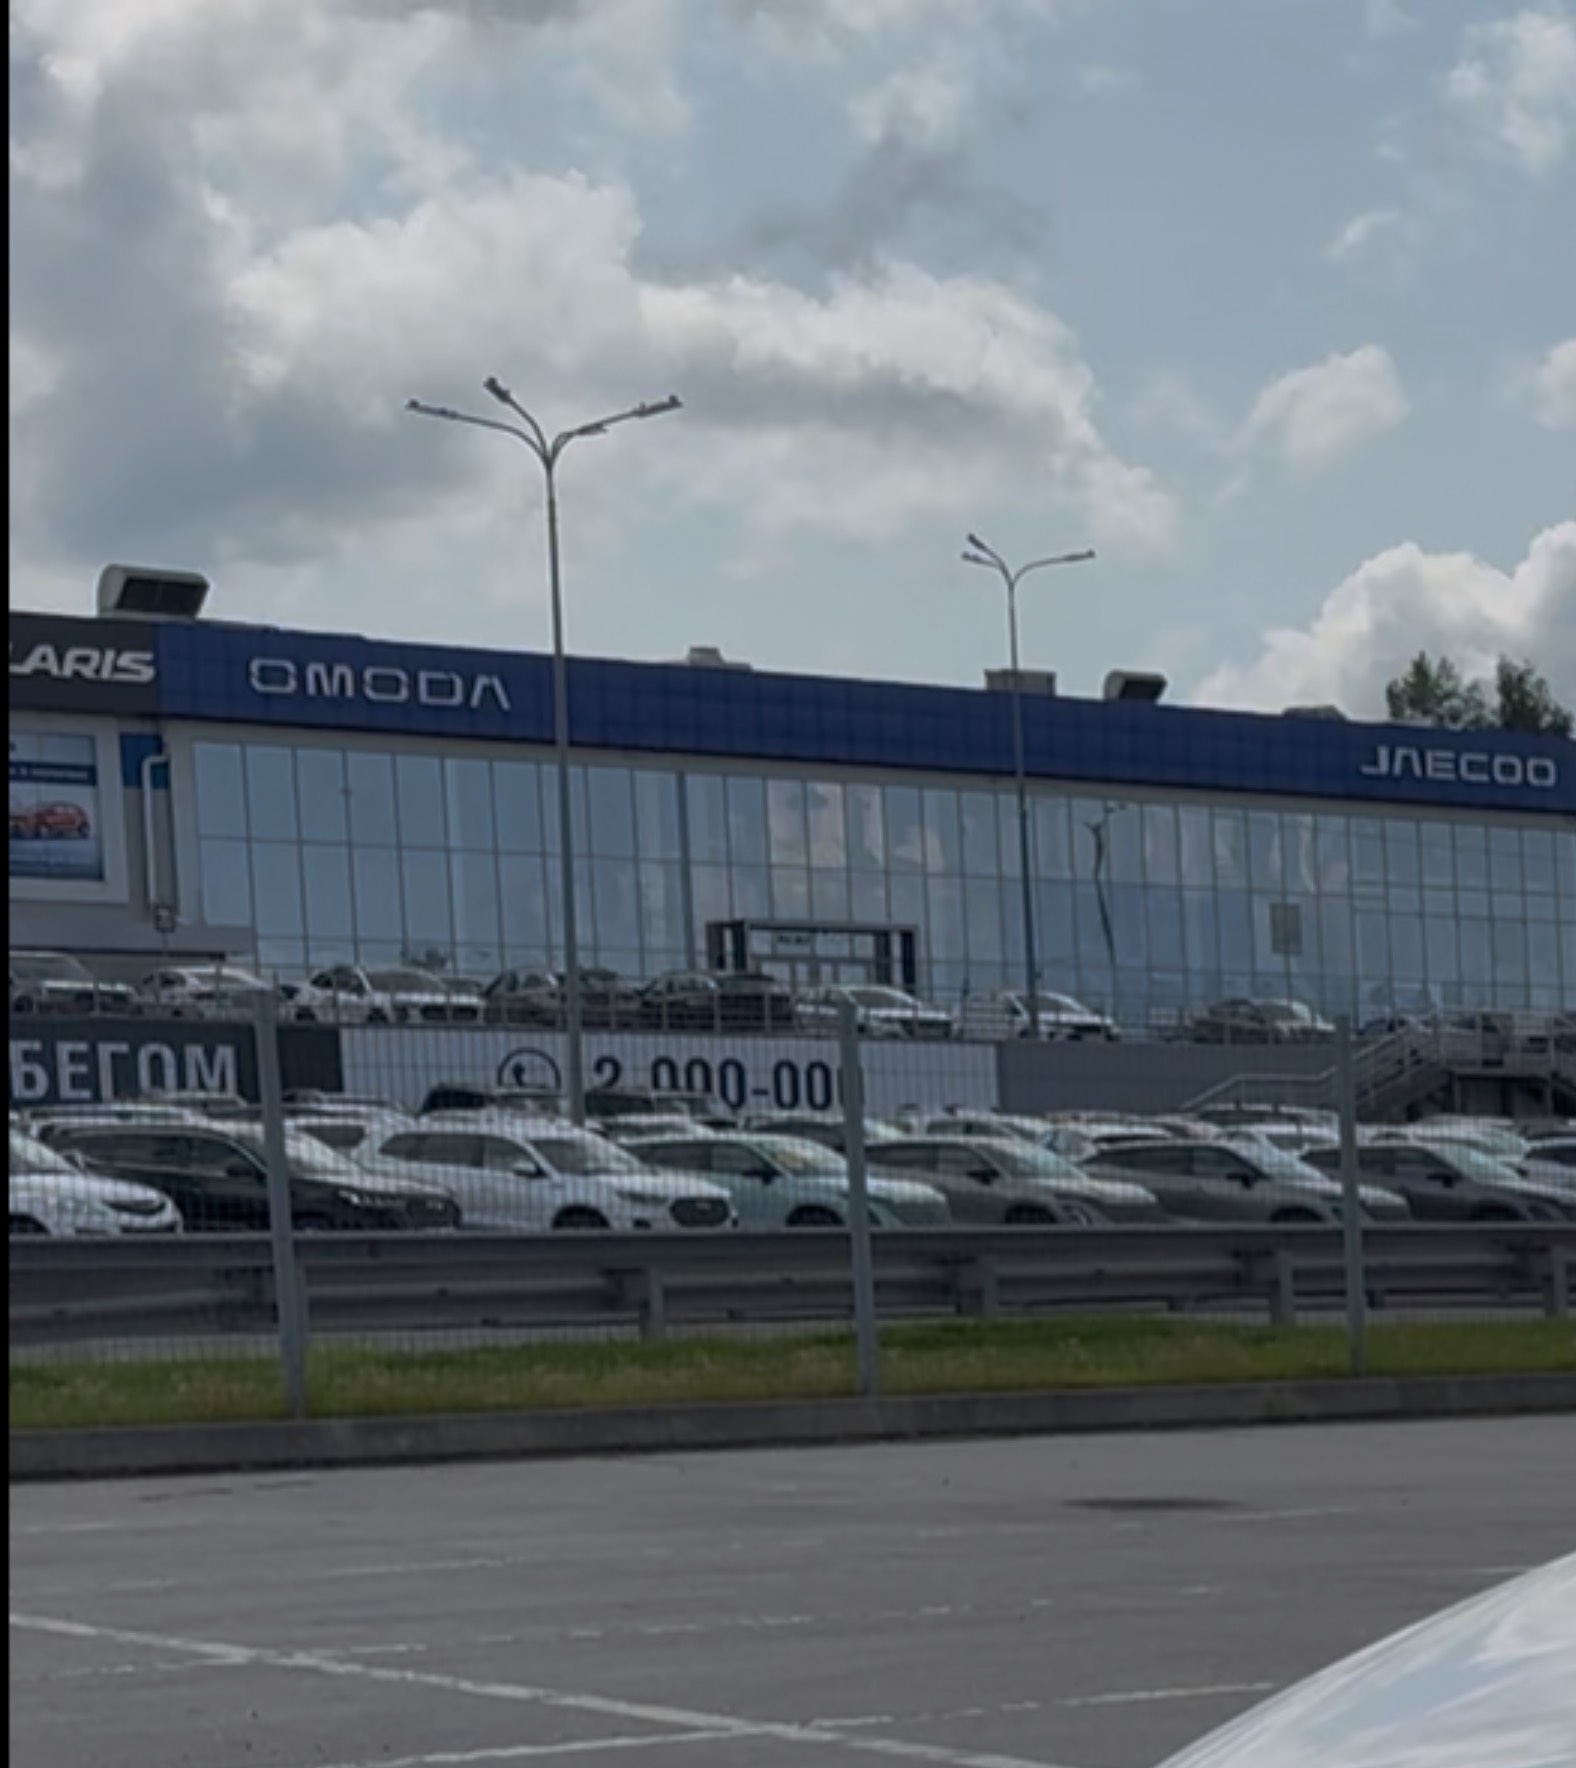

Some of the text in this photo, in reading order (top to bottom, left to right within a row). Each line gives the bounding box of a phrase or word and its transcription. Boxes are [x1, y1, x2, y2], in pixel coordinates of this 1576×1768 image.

[250, 657, 511, 711] OMODA
[1360, 746, 1556, 787] JAECOO
[9, 1040, 238, 1103] БЕГОМ
